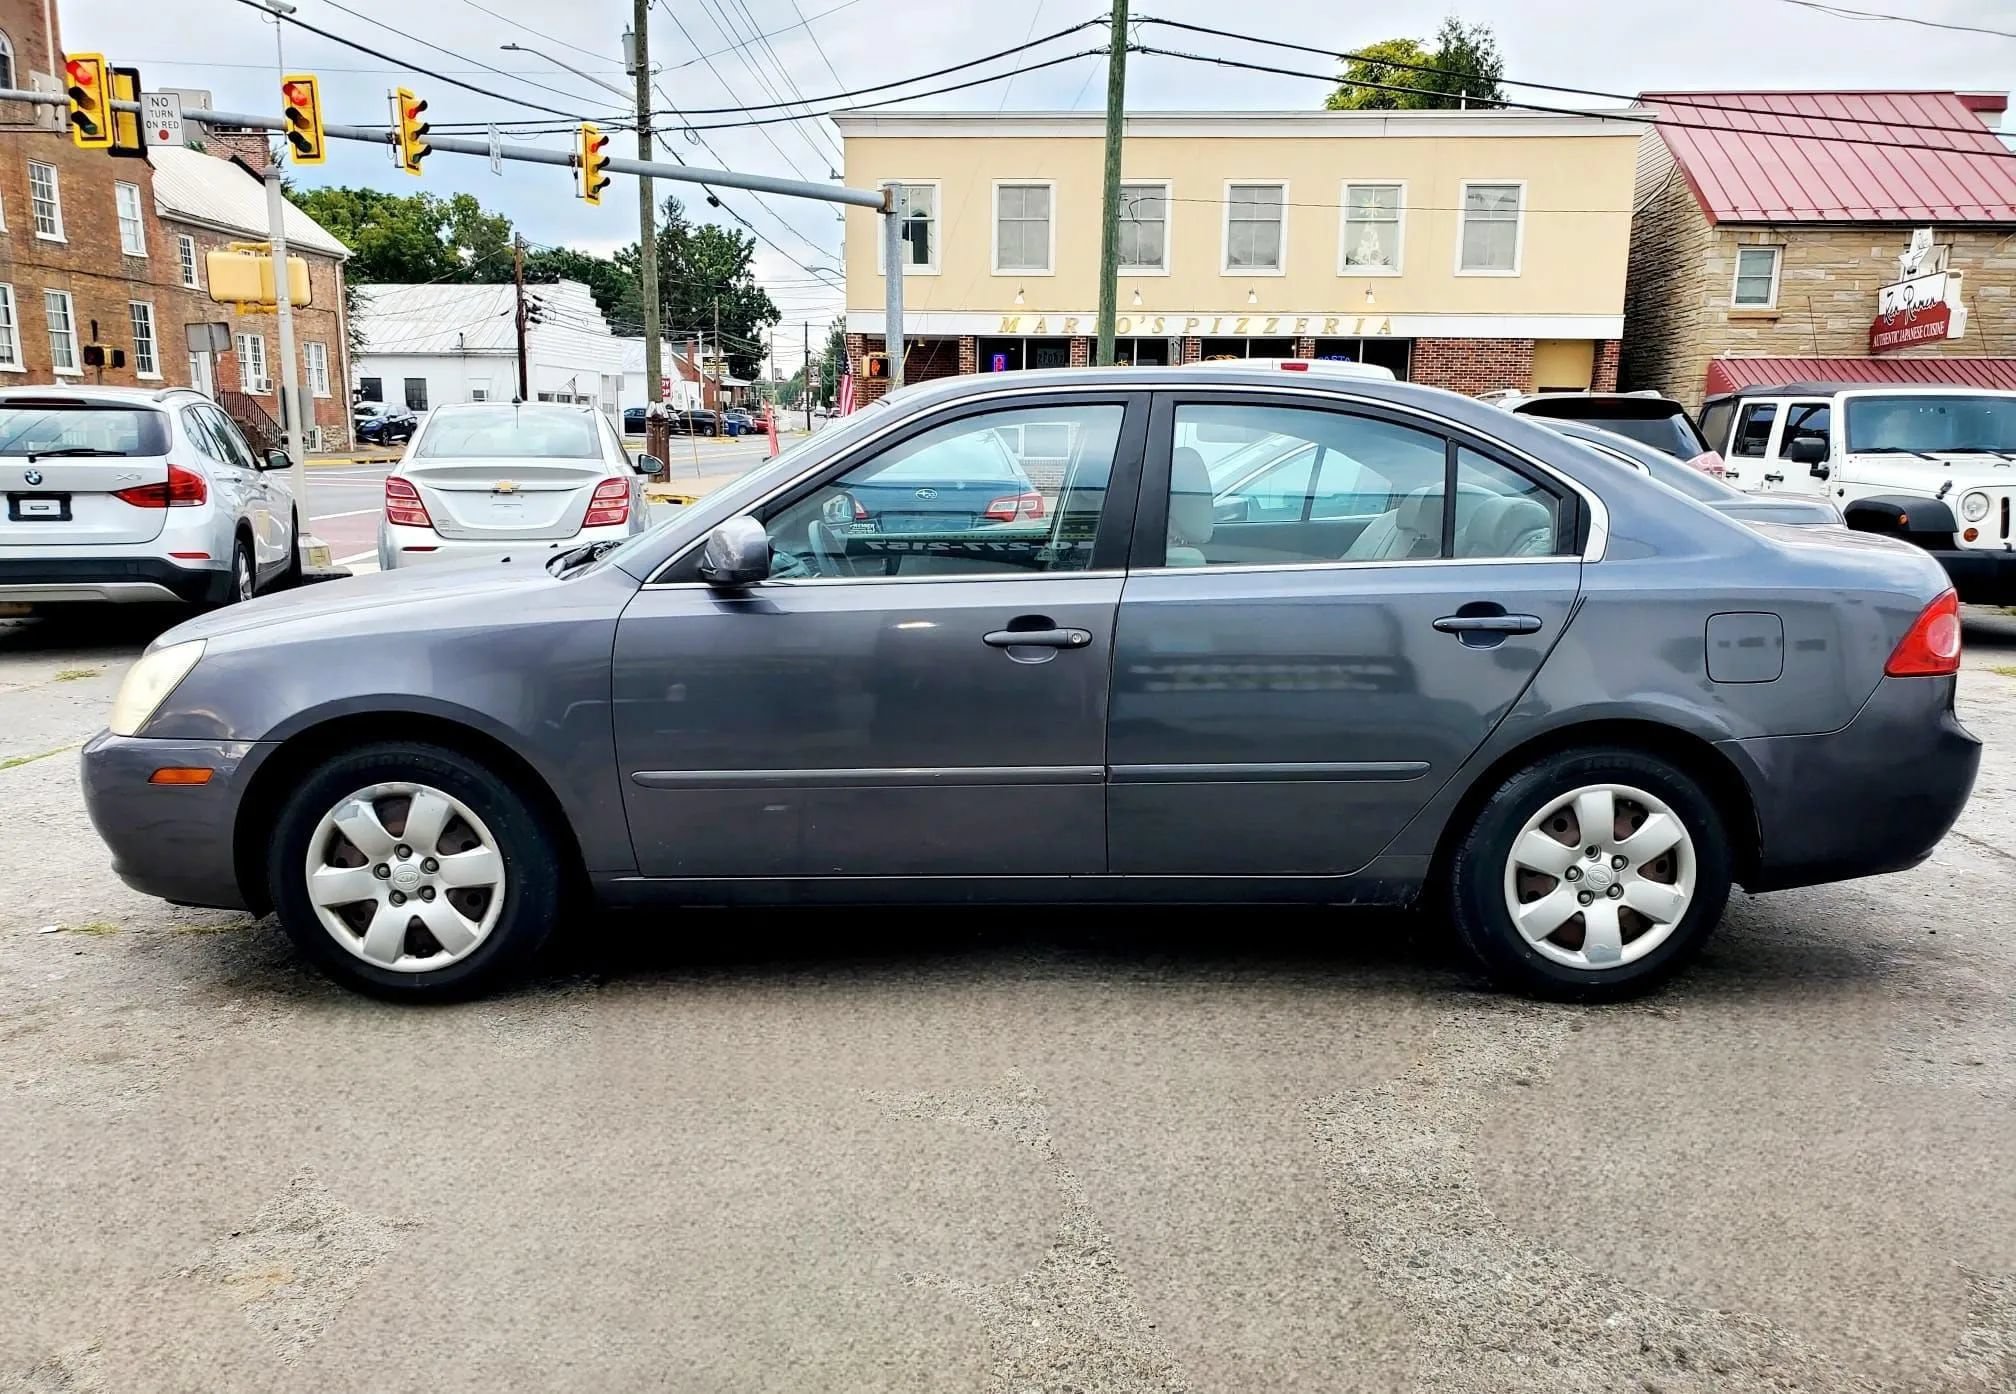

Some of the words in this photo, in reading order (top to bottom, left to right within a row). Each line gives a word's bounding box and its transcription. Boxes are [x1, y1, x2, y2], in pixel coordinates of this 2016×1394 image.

[151, 97, 169, 108] NO
[149, 110, 174, 118] TURN
[146, 120, 158, 129] ON
[162, 121, 179, 129] RED
[1903, 285, 1937, 325] Ramen
[1183, 316, 1392, 335] PIZZERIA
[1873, 330, 1899, 348] AUTHENTIC
[1899, 325, 1924, 343] JAPANESE
[1923, 321, 1945, 338] CUISINE
